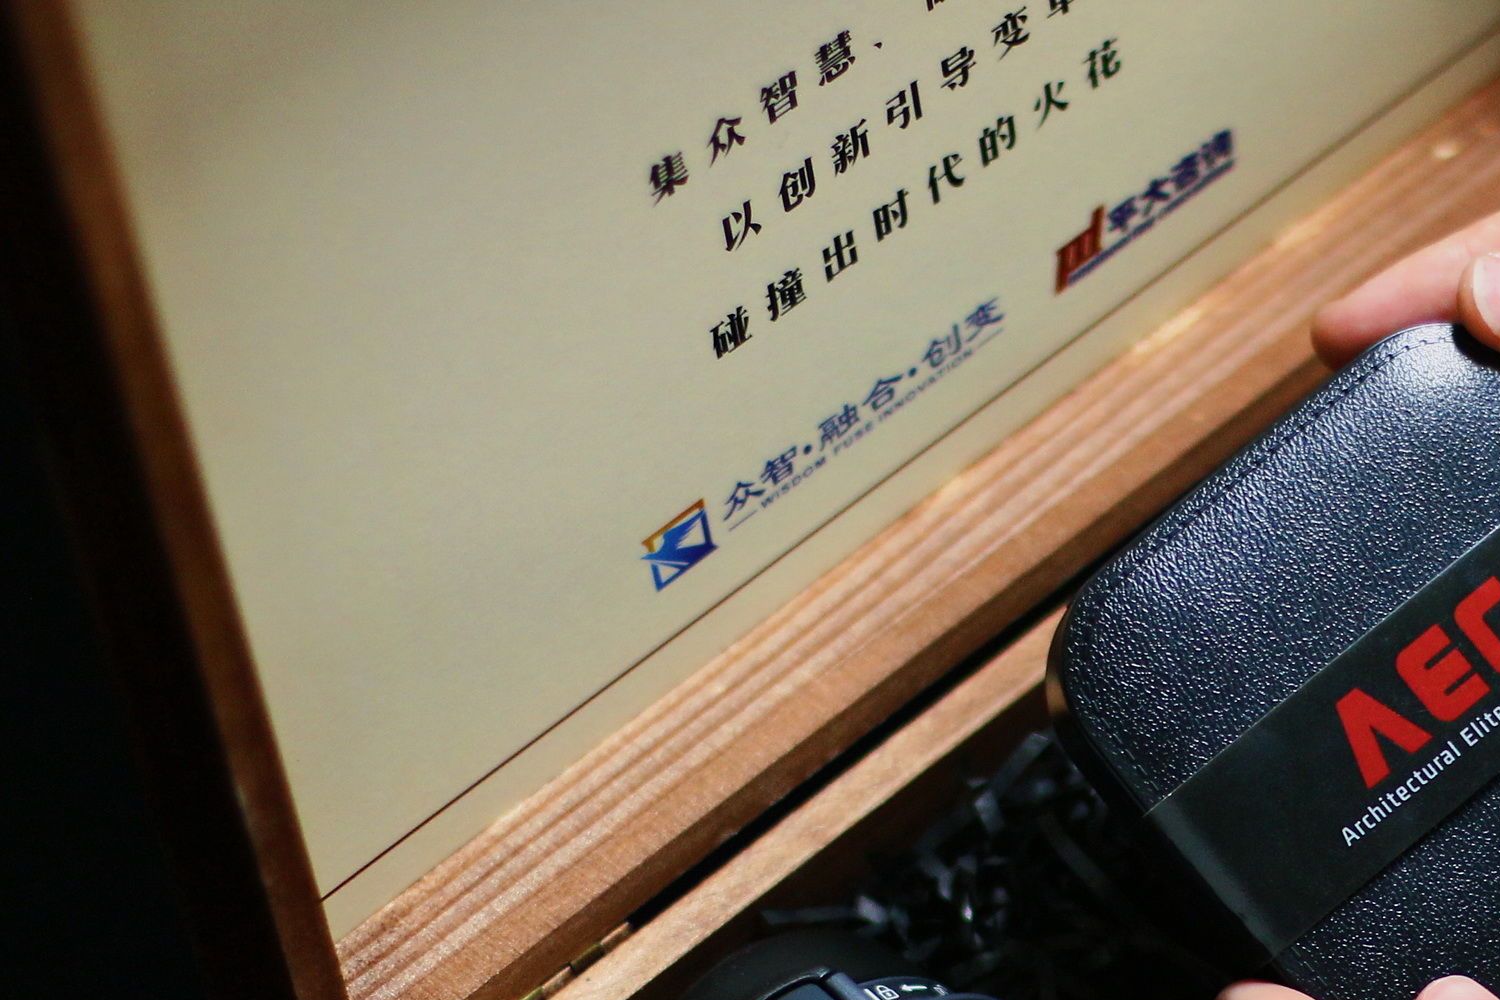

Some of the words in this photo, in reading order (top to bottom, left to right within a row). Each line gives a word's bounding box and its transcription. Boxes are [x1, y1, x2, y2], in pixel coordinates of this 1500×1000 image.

[650, 0, 945, 207] 集众智慧、
[708, 38, 1121, 360] 碰撞出时代的火花
[761, 456, 826, 509] WISDOM
[878, 347, 973, 423] INNOVATION
[1340, 741, 1461, 847] Architectural
